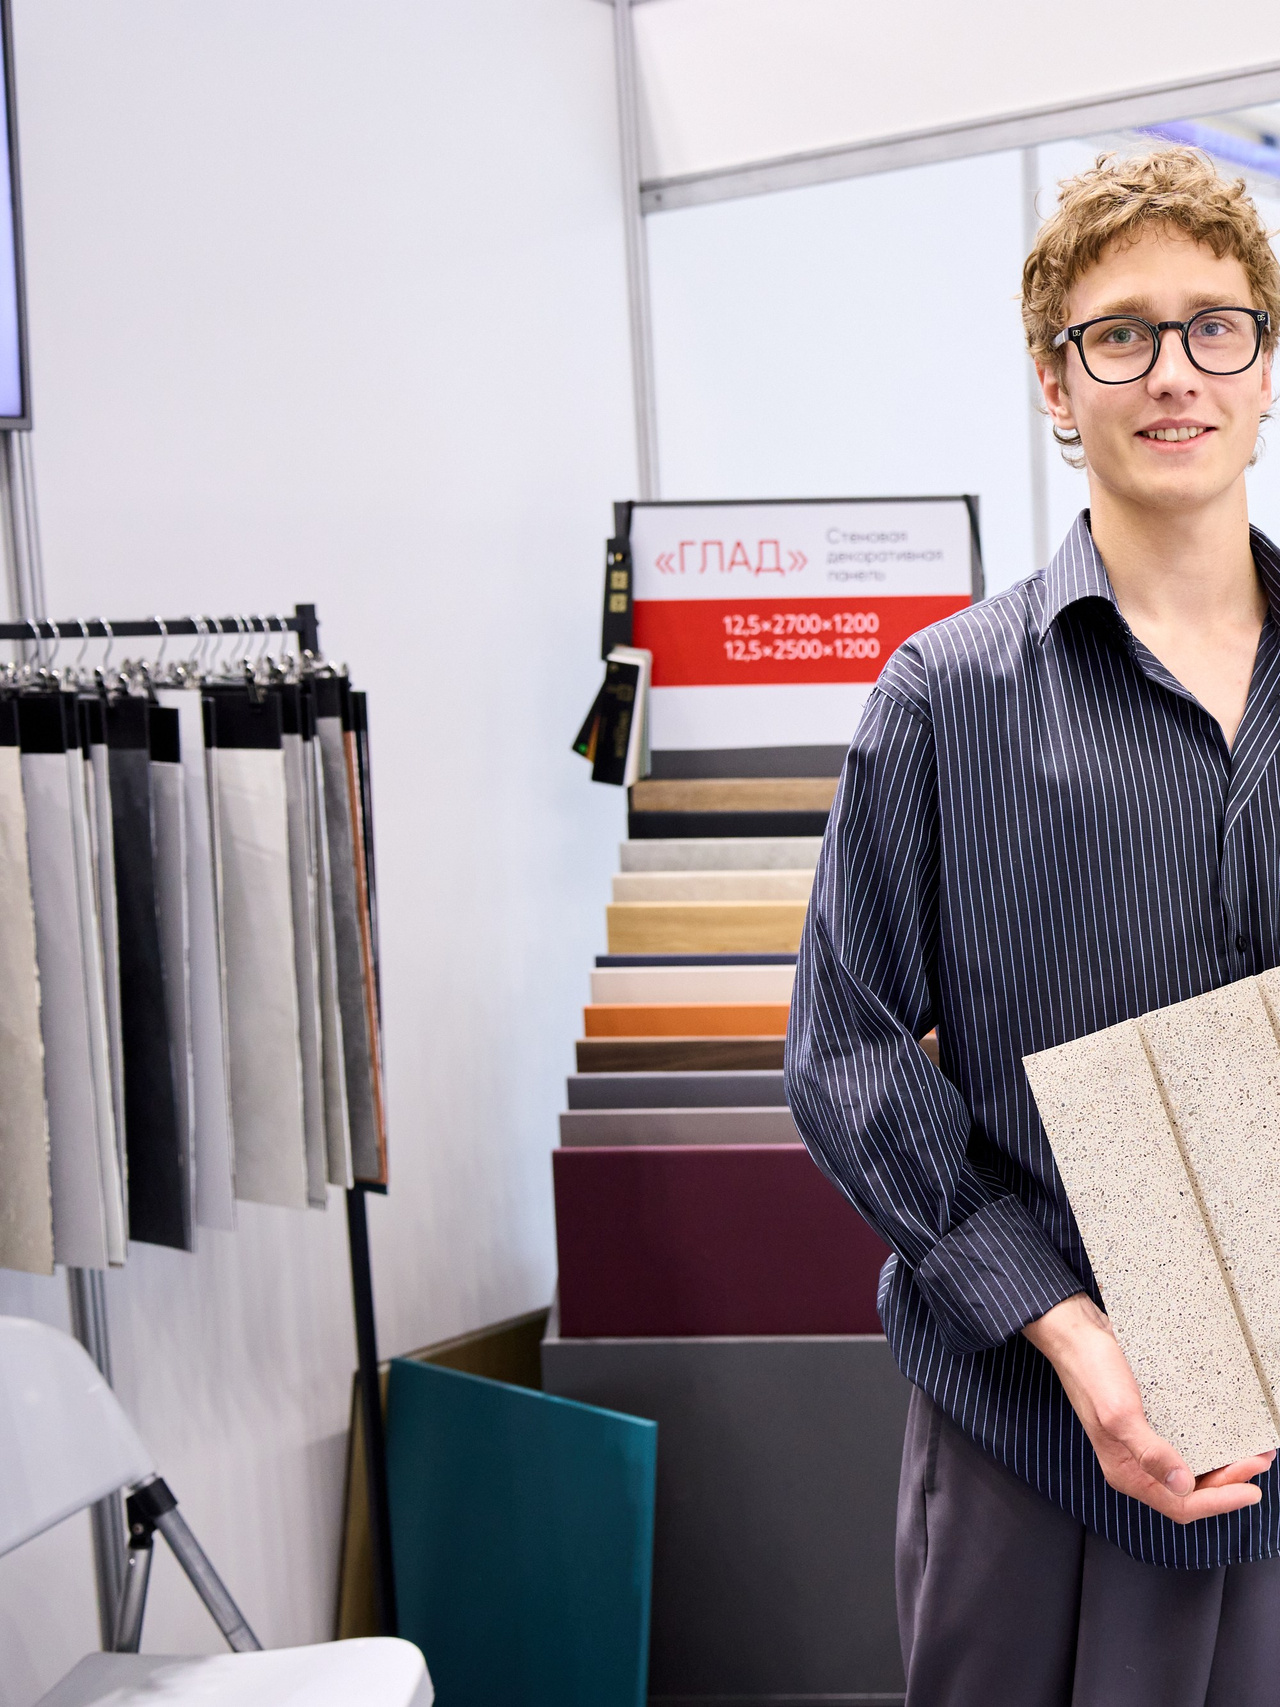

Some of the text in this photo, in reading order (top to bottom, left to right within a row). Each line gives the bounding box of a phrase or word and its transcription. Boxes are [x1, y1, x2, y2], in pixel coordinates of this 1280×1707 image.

[826, 527, 907, 544] Стеновая
[655, 539, 808, 577] «ГЛАД»
[827, 550, 943, 565] декоративная
